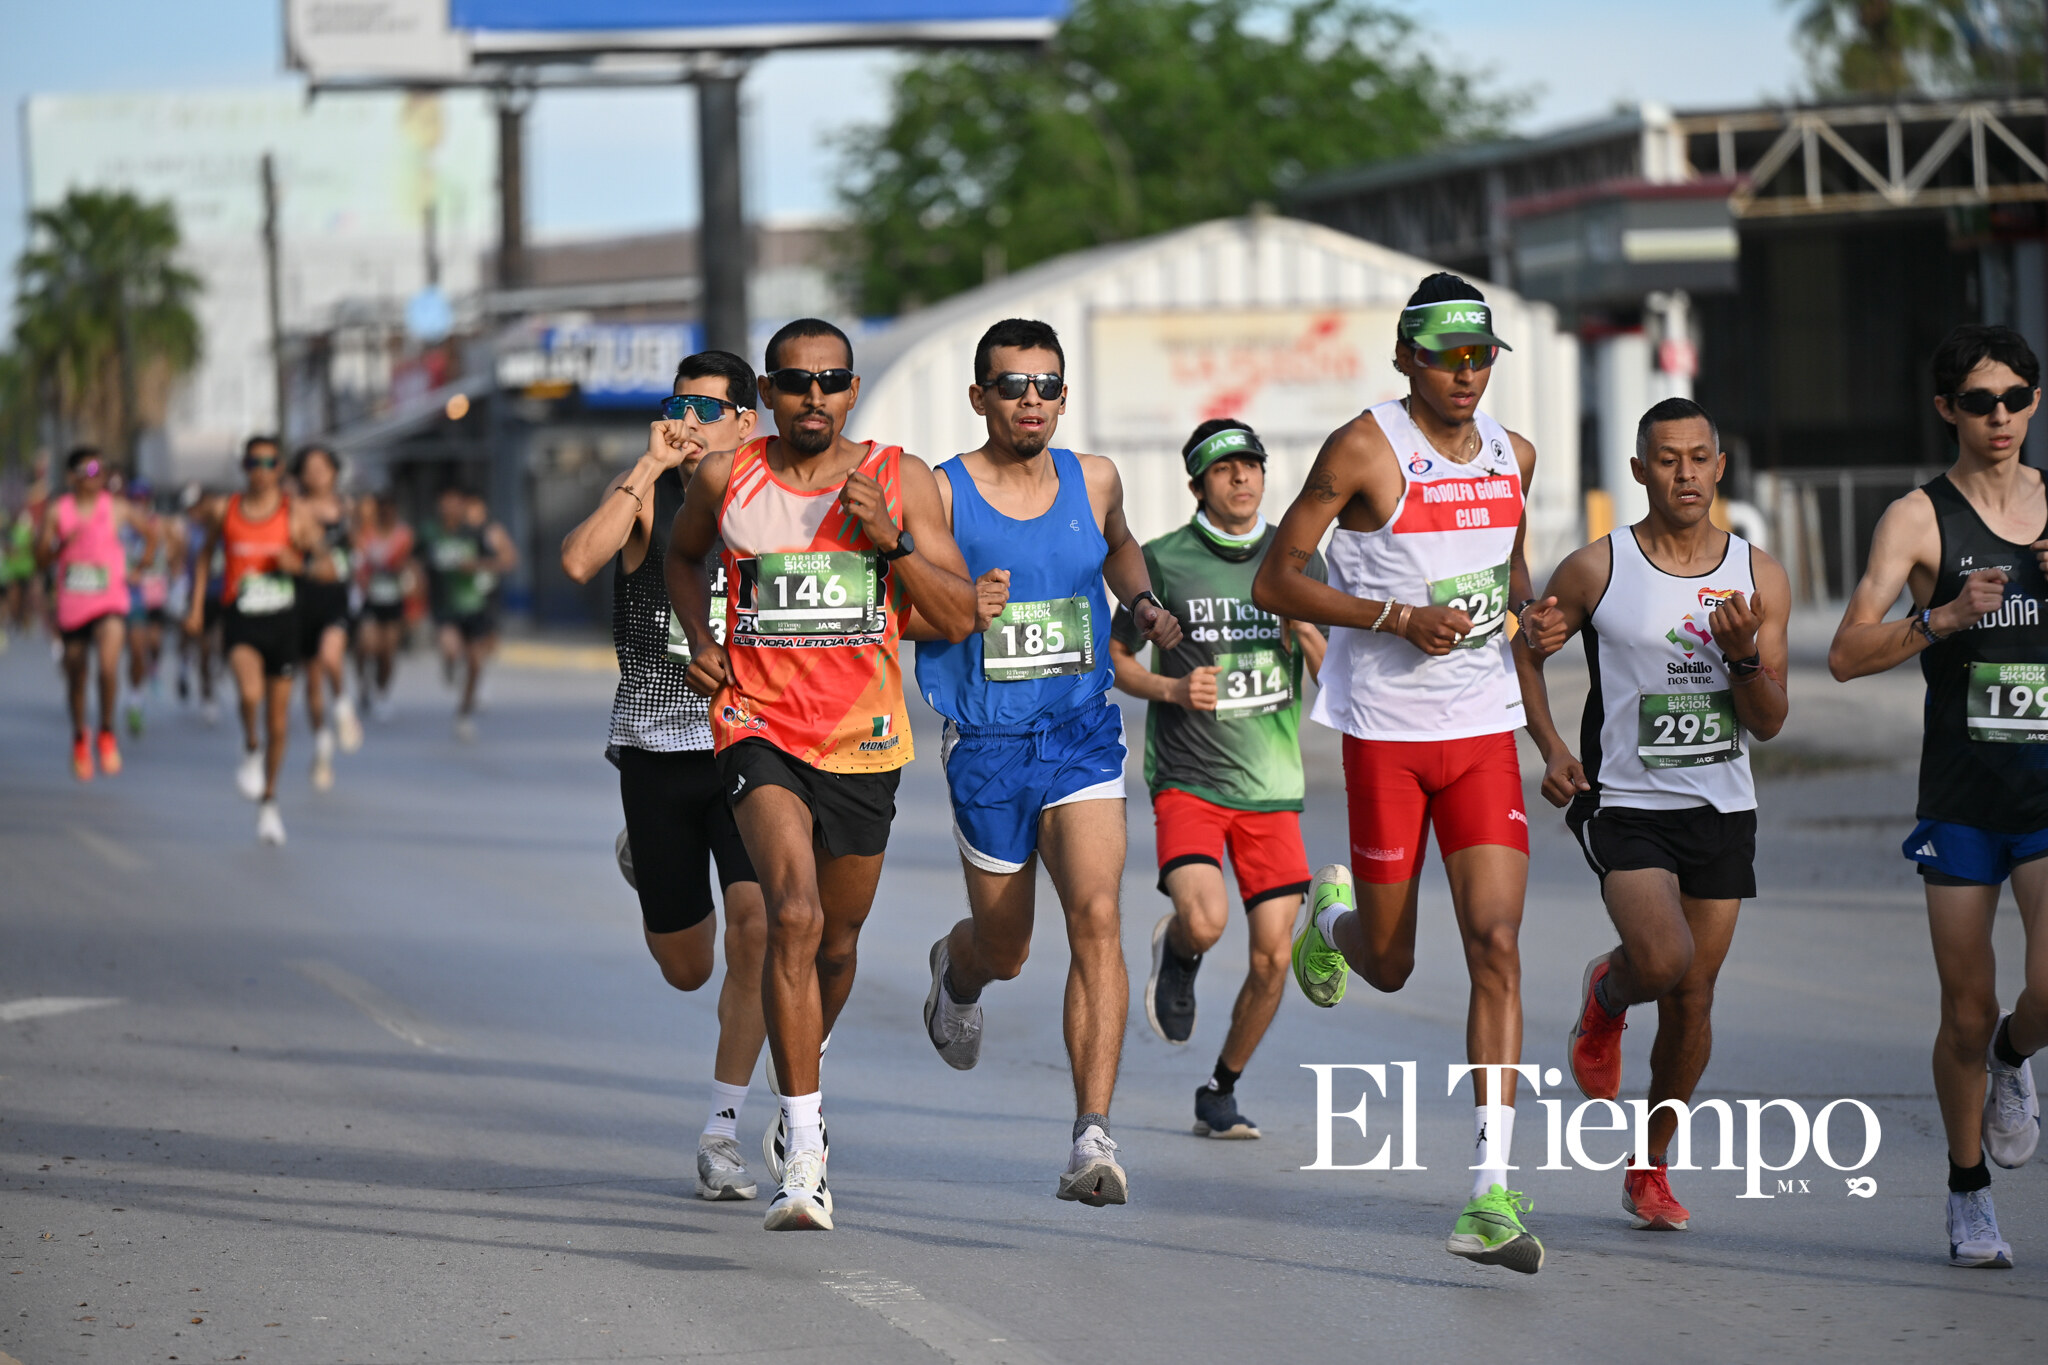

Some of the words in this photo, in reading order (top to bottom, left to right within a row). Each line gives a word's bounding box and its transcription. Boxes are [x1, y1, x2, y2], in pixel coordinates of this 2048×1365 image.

[1423, 483, 1476, 503] RODOLFO
[1474, 479, 1514, 500] GÓMEZ
[1455, 507, 1490, 528] CLUB
[863, 556, 875, 564] 146
[1455, 569, 1494, 584] CARRERA
[774, 575, 847, 608] 146
[866, 568, 874, 621] MEDALLA
[1012, 602, 1051, 611] CARRERA
[1186, 597, 1215, 623] El
[733, 637, 756, 645] CLUB
[756, 638, 793, 647] NORA
[795, 637, 847, 647] LETICIA
[1001, 621, 1065, 656] 185
[1082, 614, 1092, 664] MEDALLA
[1191, 626, 1219, 642] de
[1221, 625, 1281, 642] todos
[1667, 661, 1712, 674] Saltillo
[1227, 666, 1281, 698] 314
[1668, 676, 1688, 685] nos
[1690, 675, 1714, 684] une.
[1667, 694, 1711, 702] CARRERA
[1986, 685, 2048, 718] 199
[1653, 712, 1720, 744] 295
[858, 735, 899, 751] MONCLOVA
